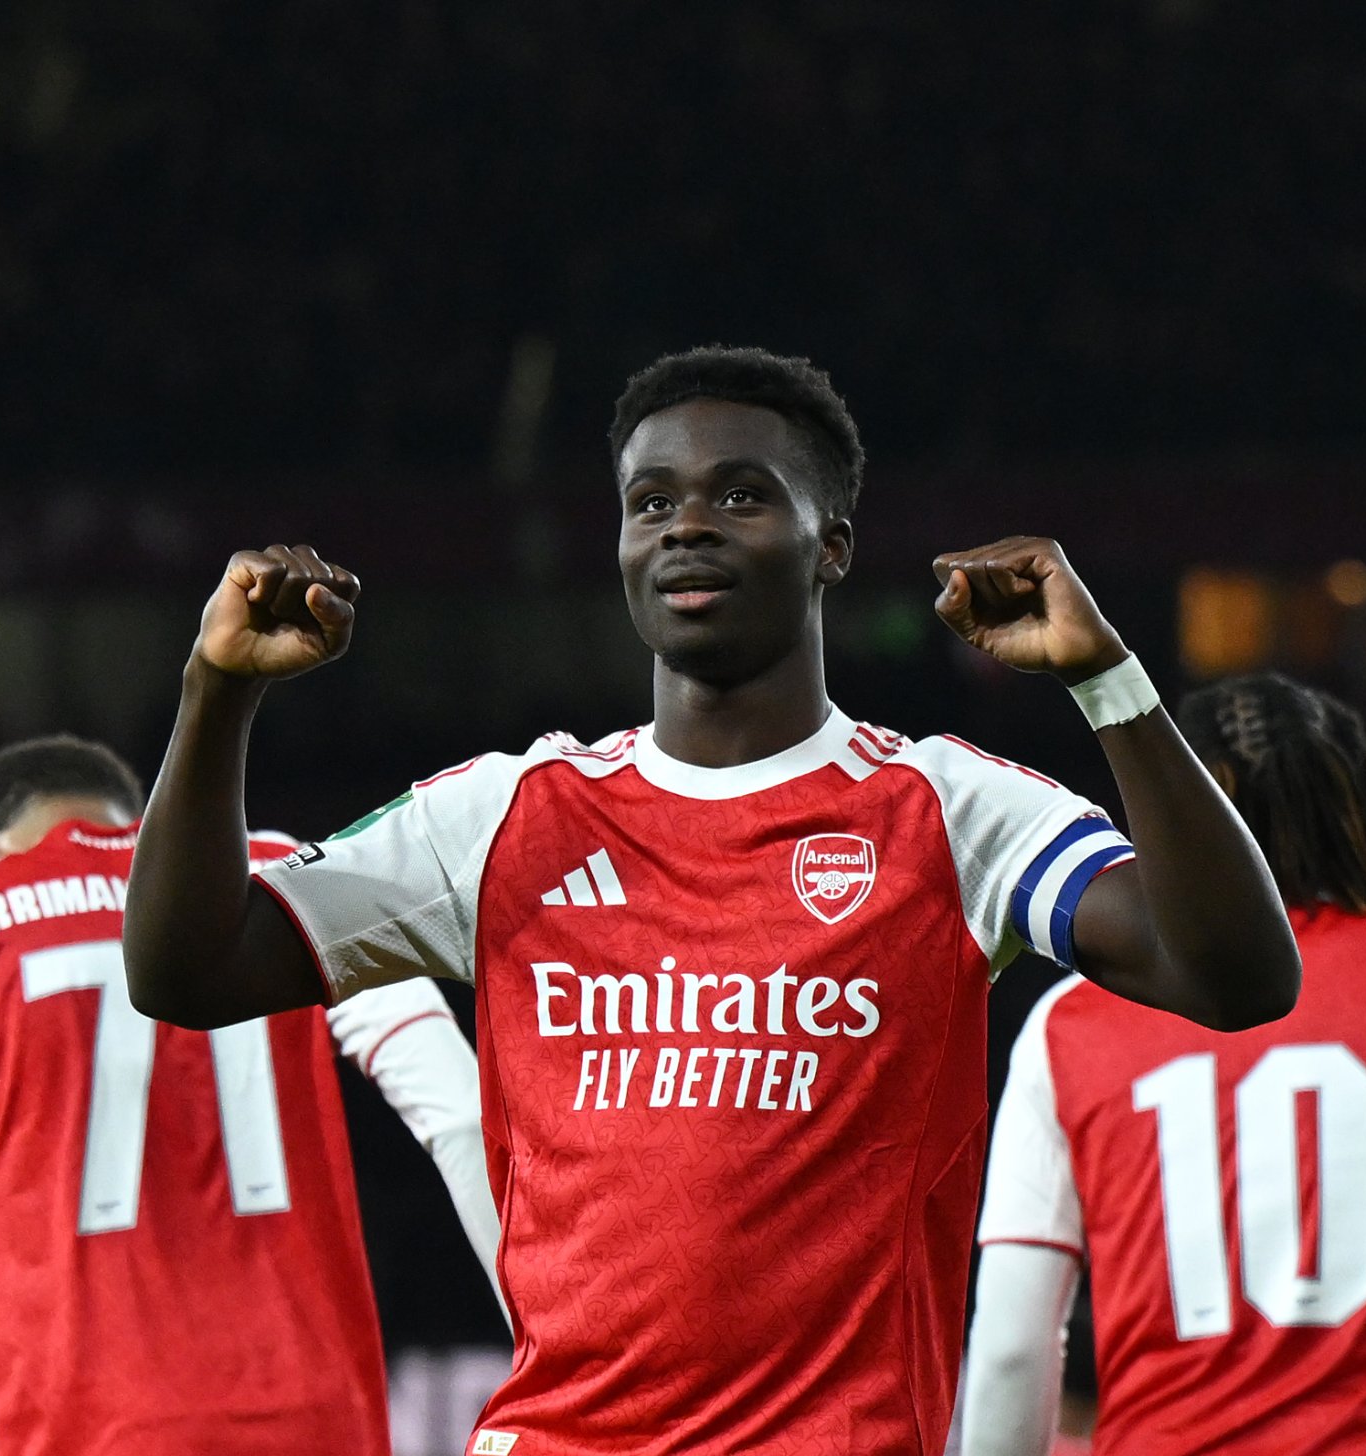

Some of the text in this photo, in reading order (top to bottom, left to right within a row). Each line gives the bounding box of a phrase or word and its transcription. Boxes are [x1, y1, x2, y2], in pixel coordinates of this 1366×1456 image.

[804, 849, 865, 865] Arsenal
[530, 956, 880, 1038] Emirates
[20, 938, 291, 1236] 71
[573, 1047, 819, 1112] FLY BETTER
